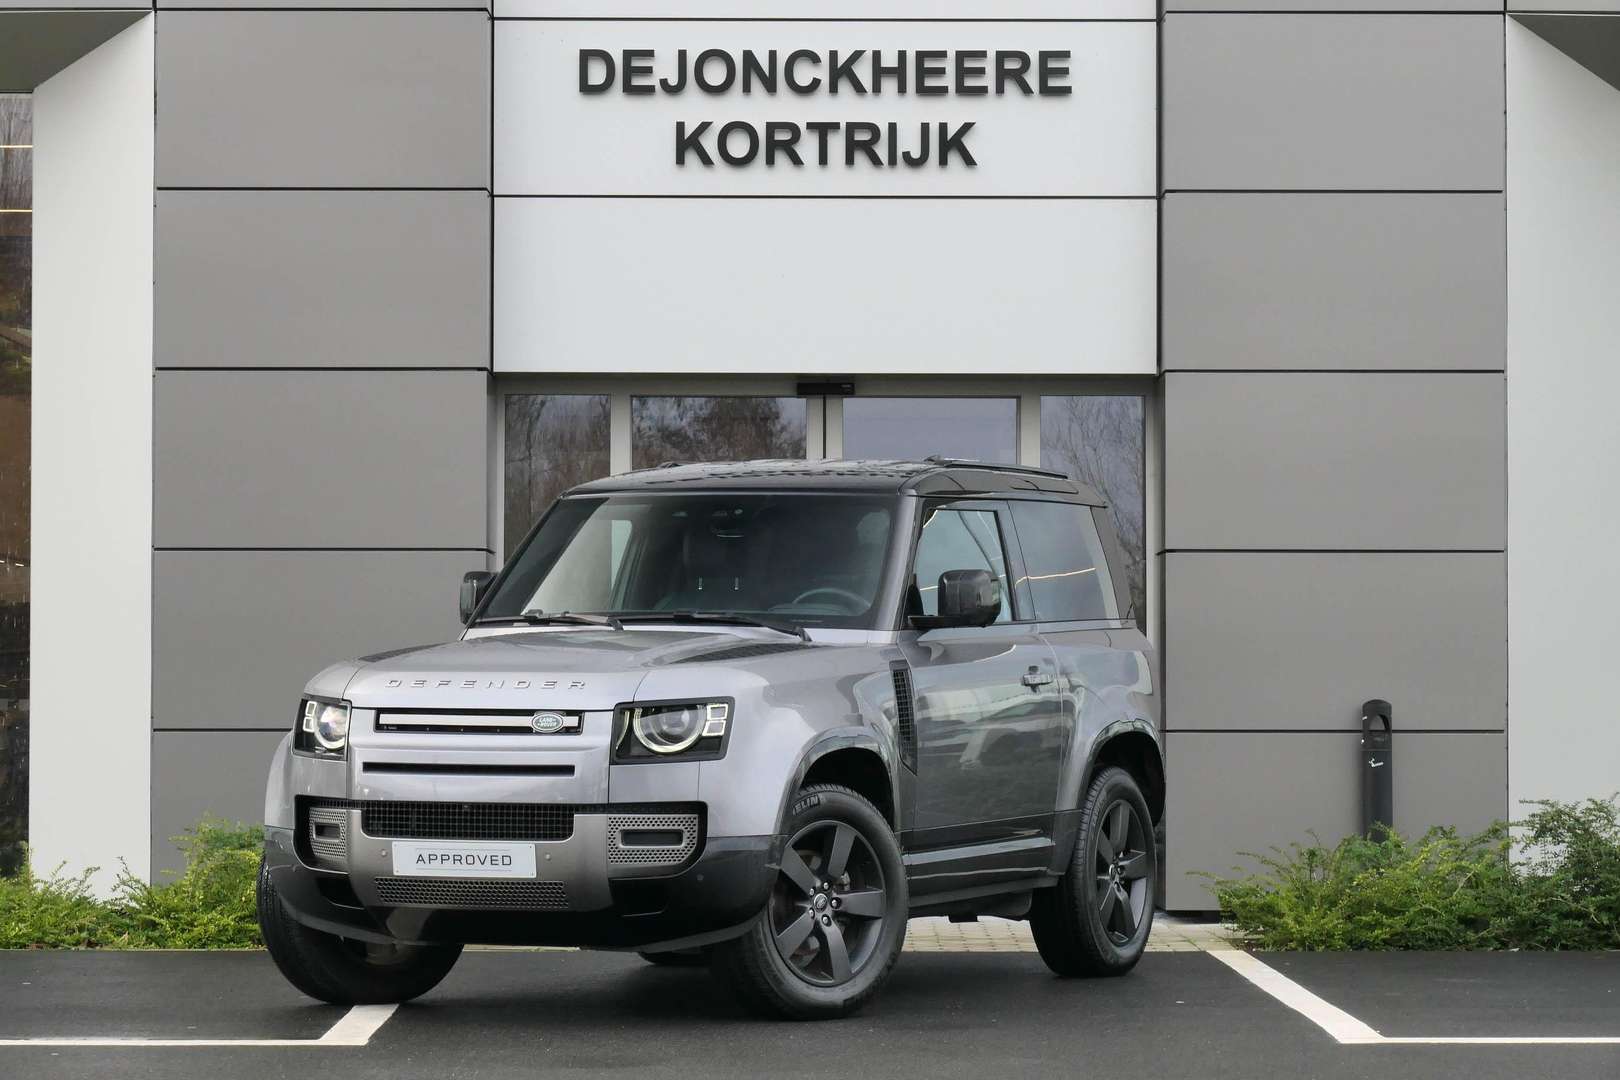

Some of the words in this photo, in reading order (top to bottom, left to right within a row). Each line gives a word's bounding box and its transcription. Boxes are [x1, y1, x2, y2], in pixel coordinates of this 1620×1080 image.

[579, 49, 1072, 97] DEJONCKHEERE
[676, 121, 977, 168] KORTRIJK
[385, 679, 587, 690] DEFENDER
[416, 853, 512, 866] APPROVED
